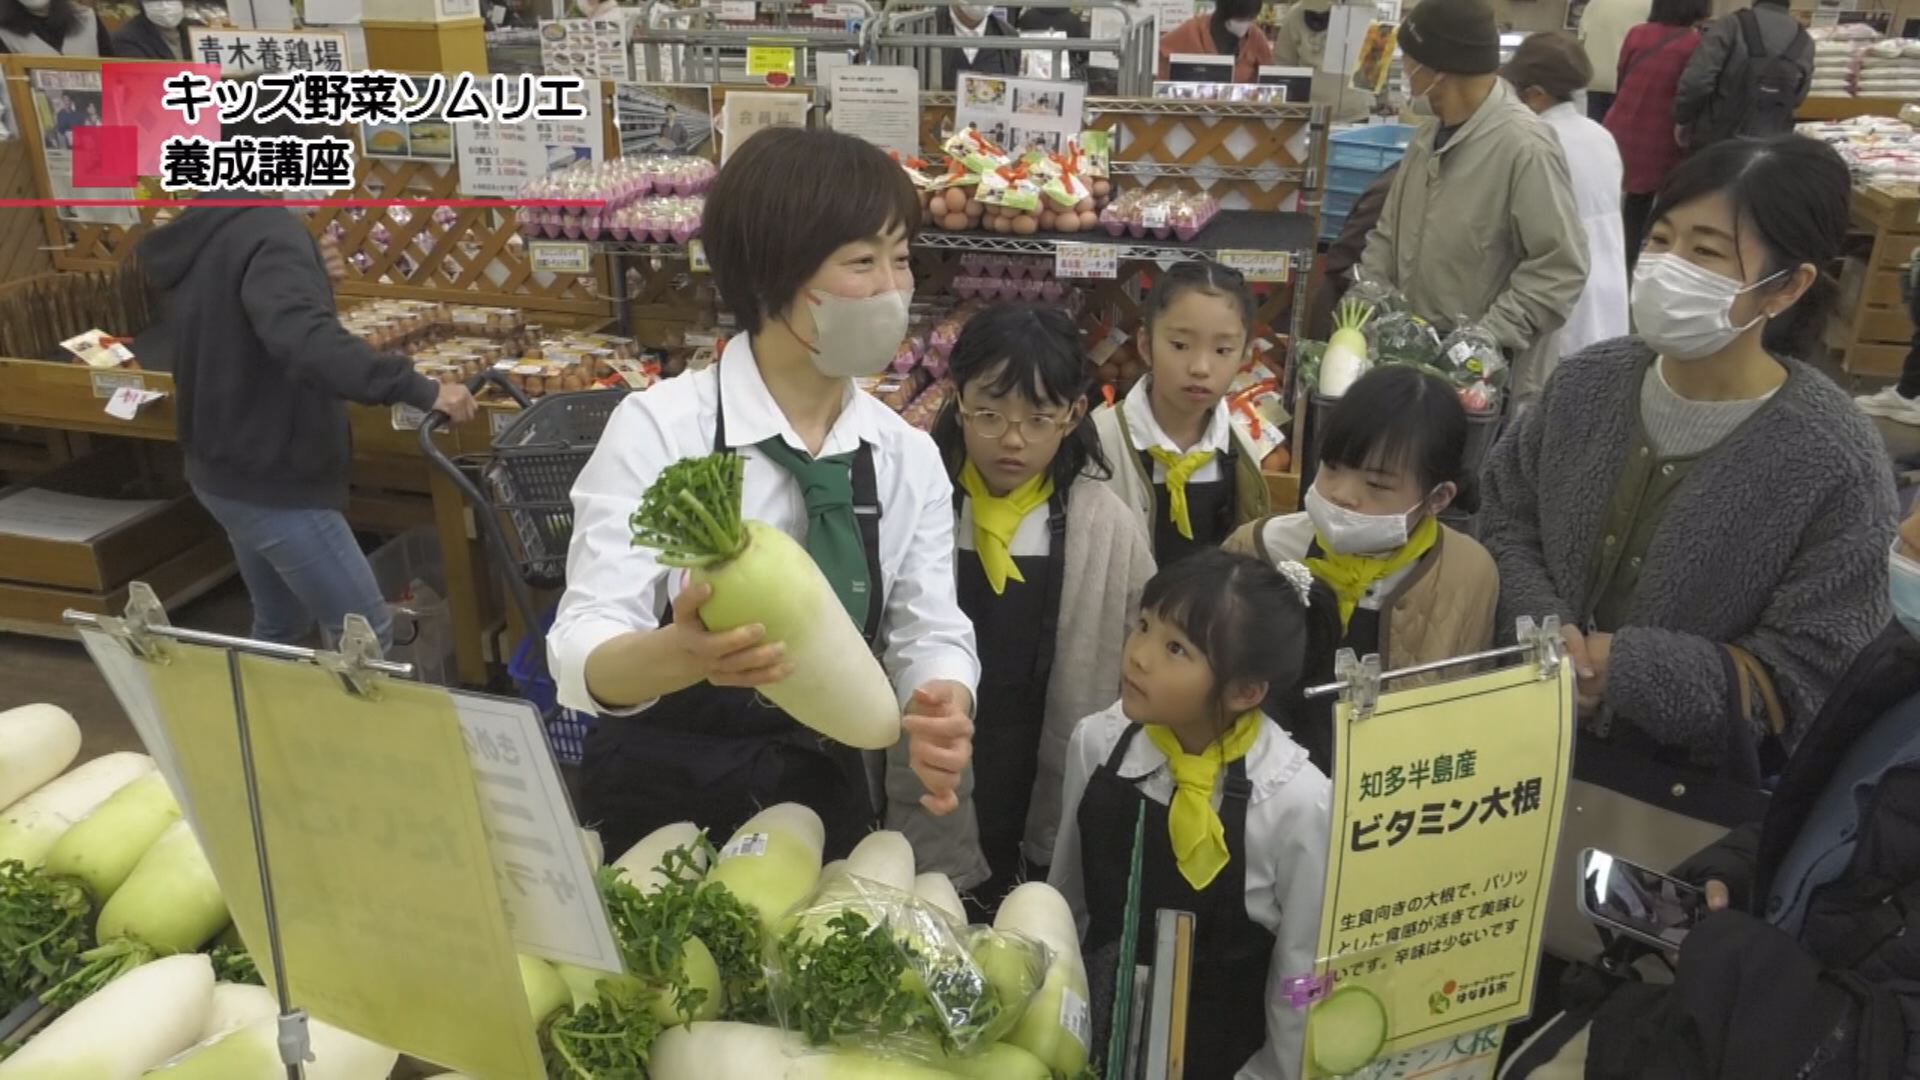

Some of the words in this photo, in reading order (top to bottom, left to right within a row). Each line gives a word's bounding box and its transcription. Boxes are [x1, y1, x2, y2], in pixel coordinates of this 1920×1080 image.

[198, 35, 342, 73] 青木養鶏場
[1359, 749, 1477, 801] 知多半島産
[1351, 777, 1542, 851] ビタミン大根
